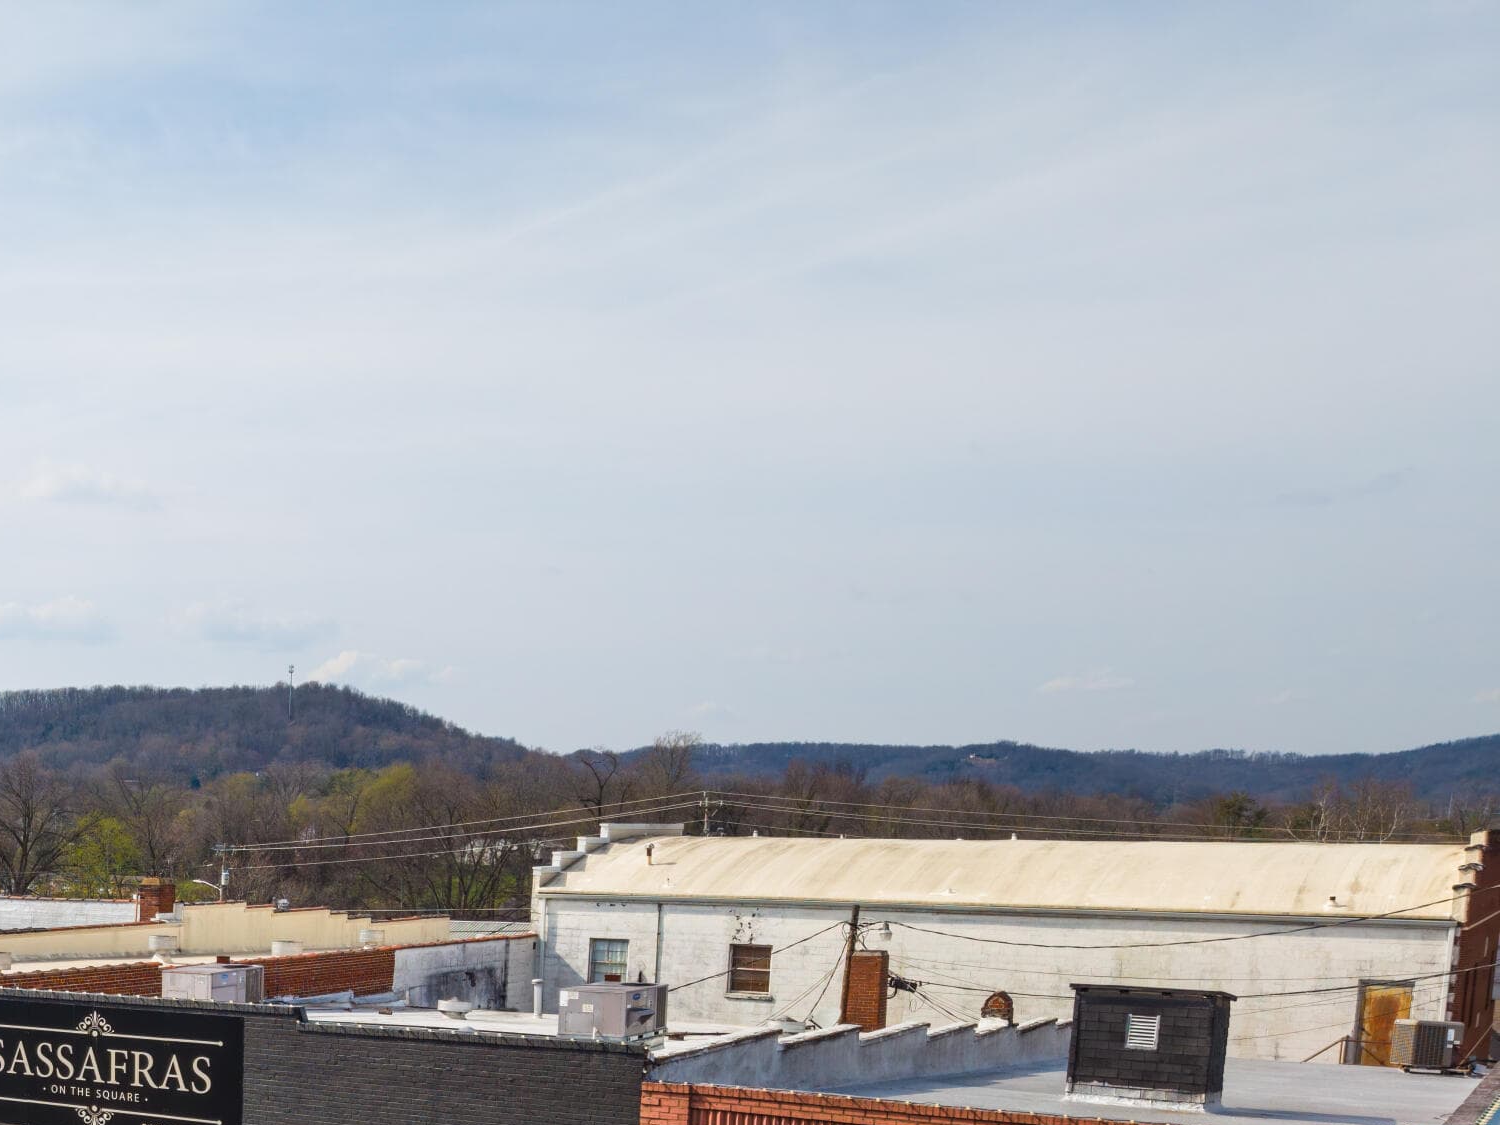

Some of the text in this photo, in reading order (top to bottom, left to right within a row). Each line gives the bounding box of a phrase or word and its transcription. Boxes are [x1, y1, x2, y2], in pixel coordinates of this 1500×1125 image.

[51, 1084, 140, 1103] ON THE SQUARE
